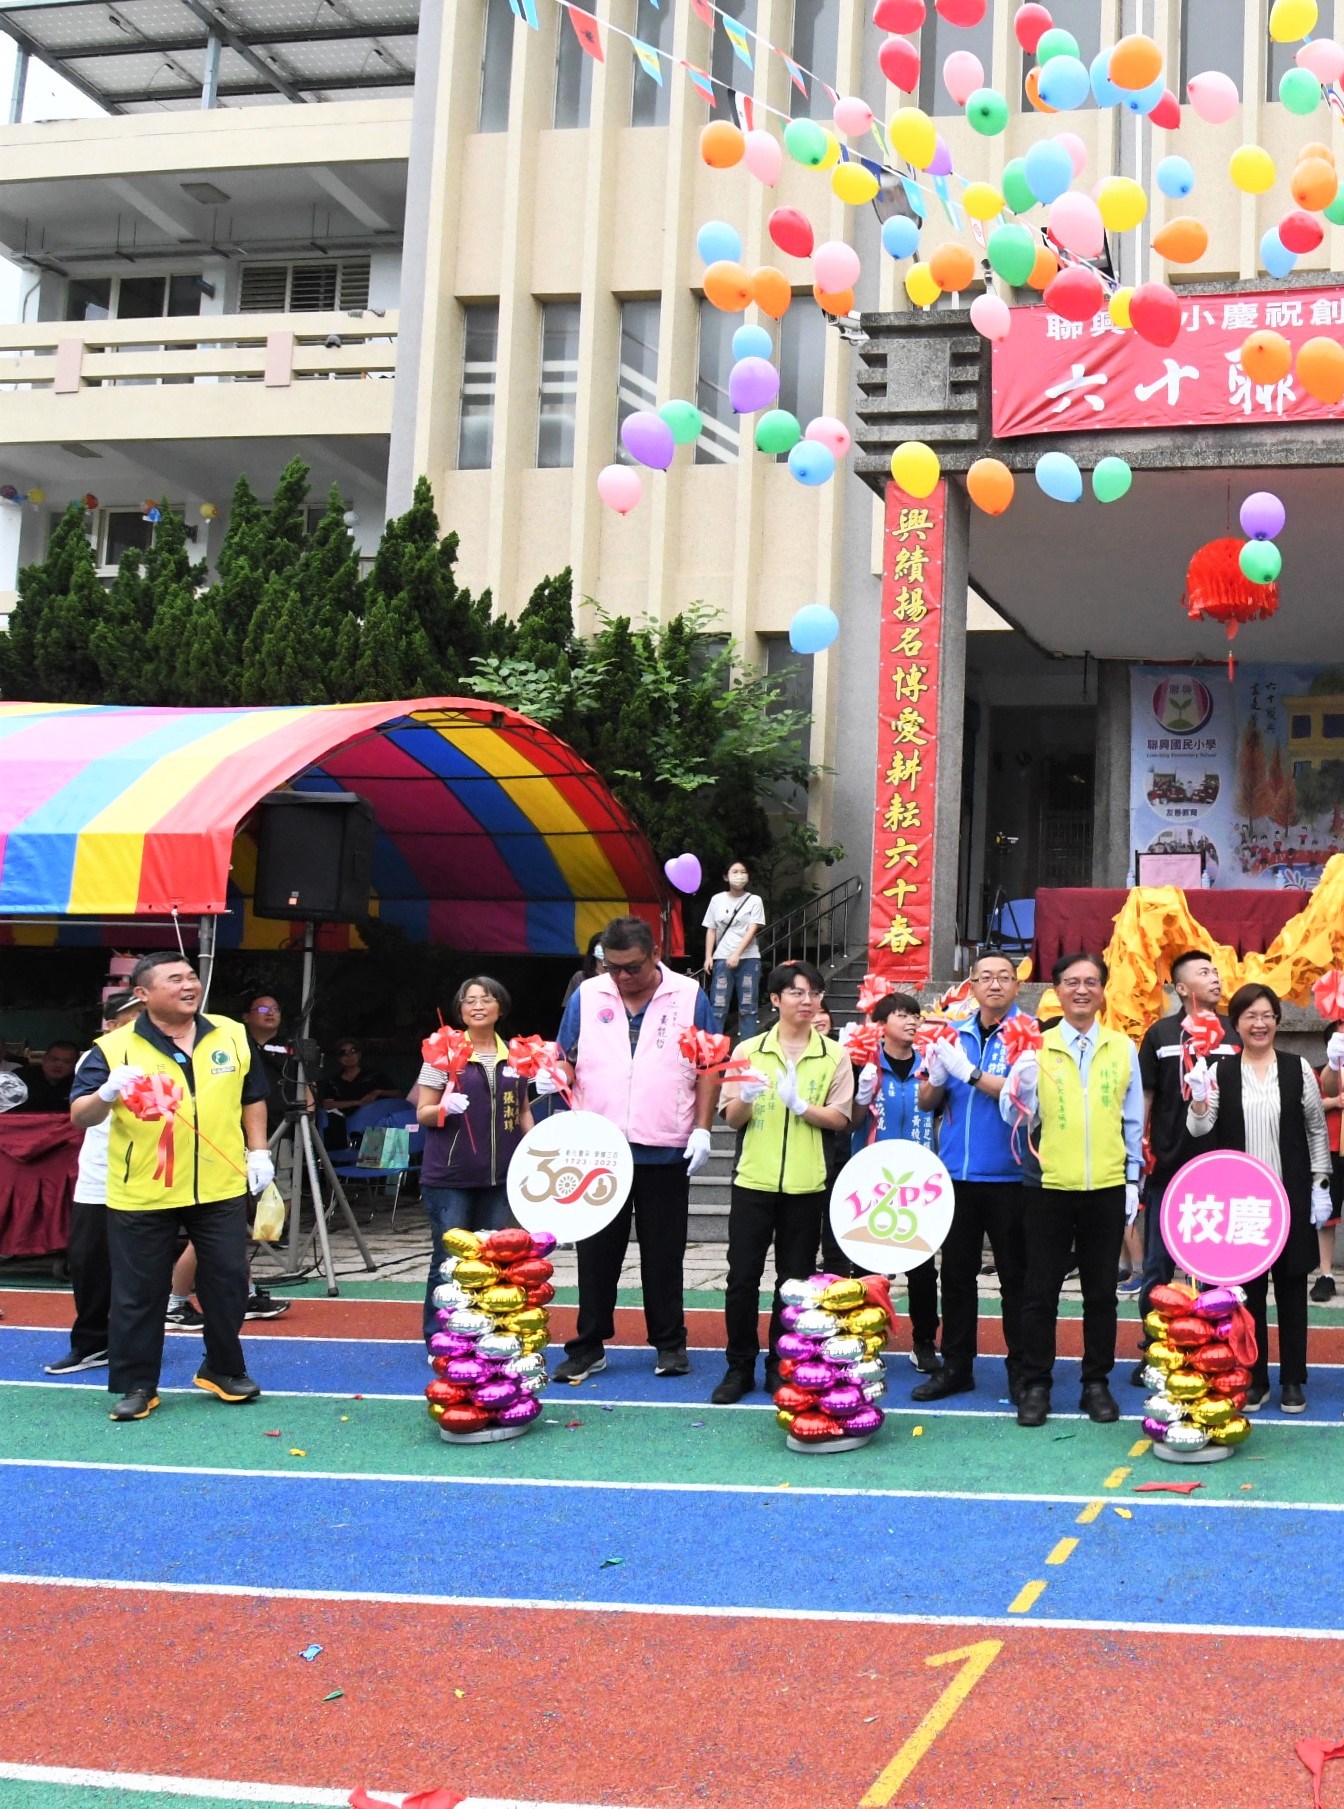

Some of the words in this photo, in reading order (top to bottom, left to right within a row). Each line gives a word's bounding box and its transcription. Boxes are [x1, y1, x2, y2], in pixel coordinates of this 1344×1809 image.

[876, 508, 934, 954] 興績揚名博愛耕耘六十春
[1147, 738, 1217, 751] 聯興國民小學
[1177, 1193, 1273, 1247] 校慶
